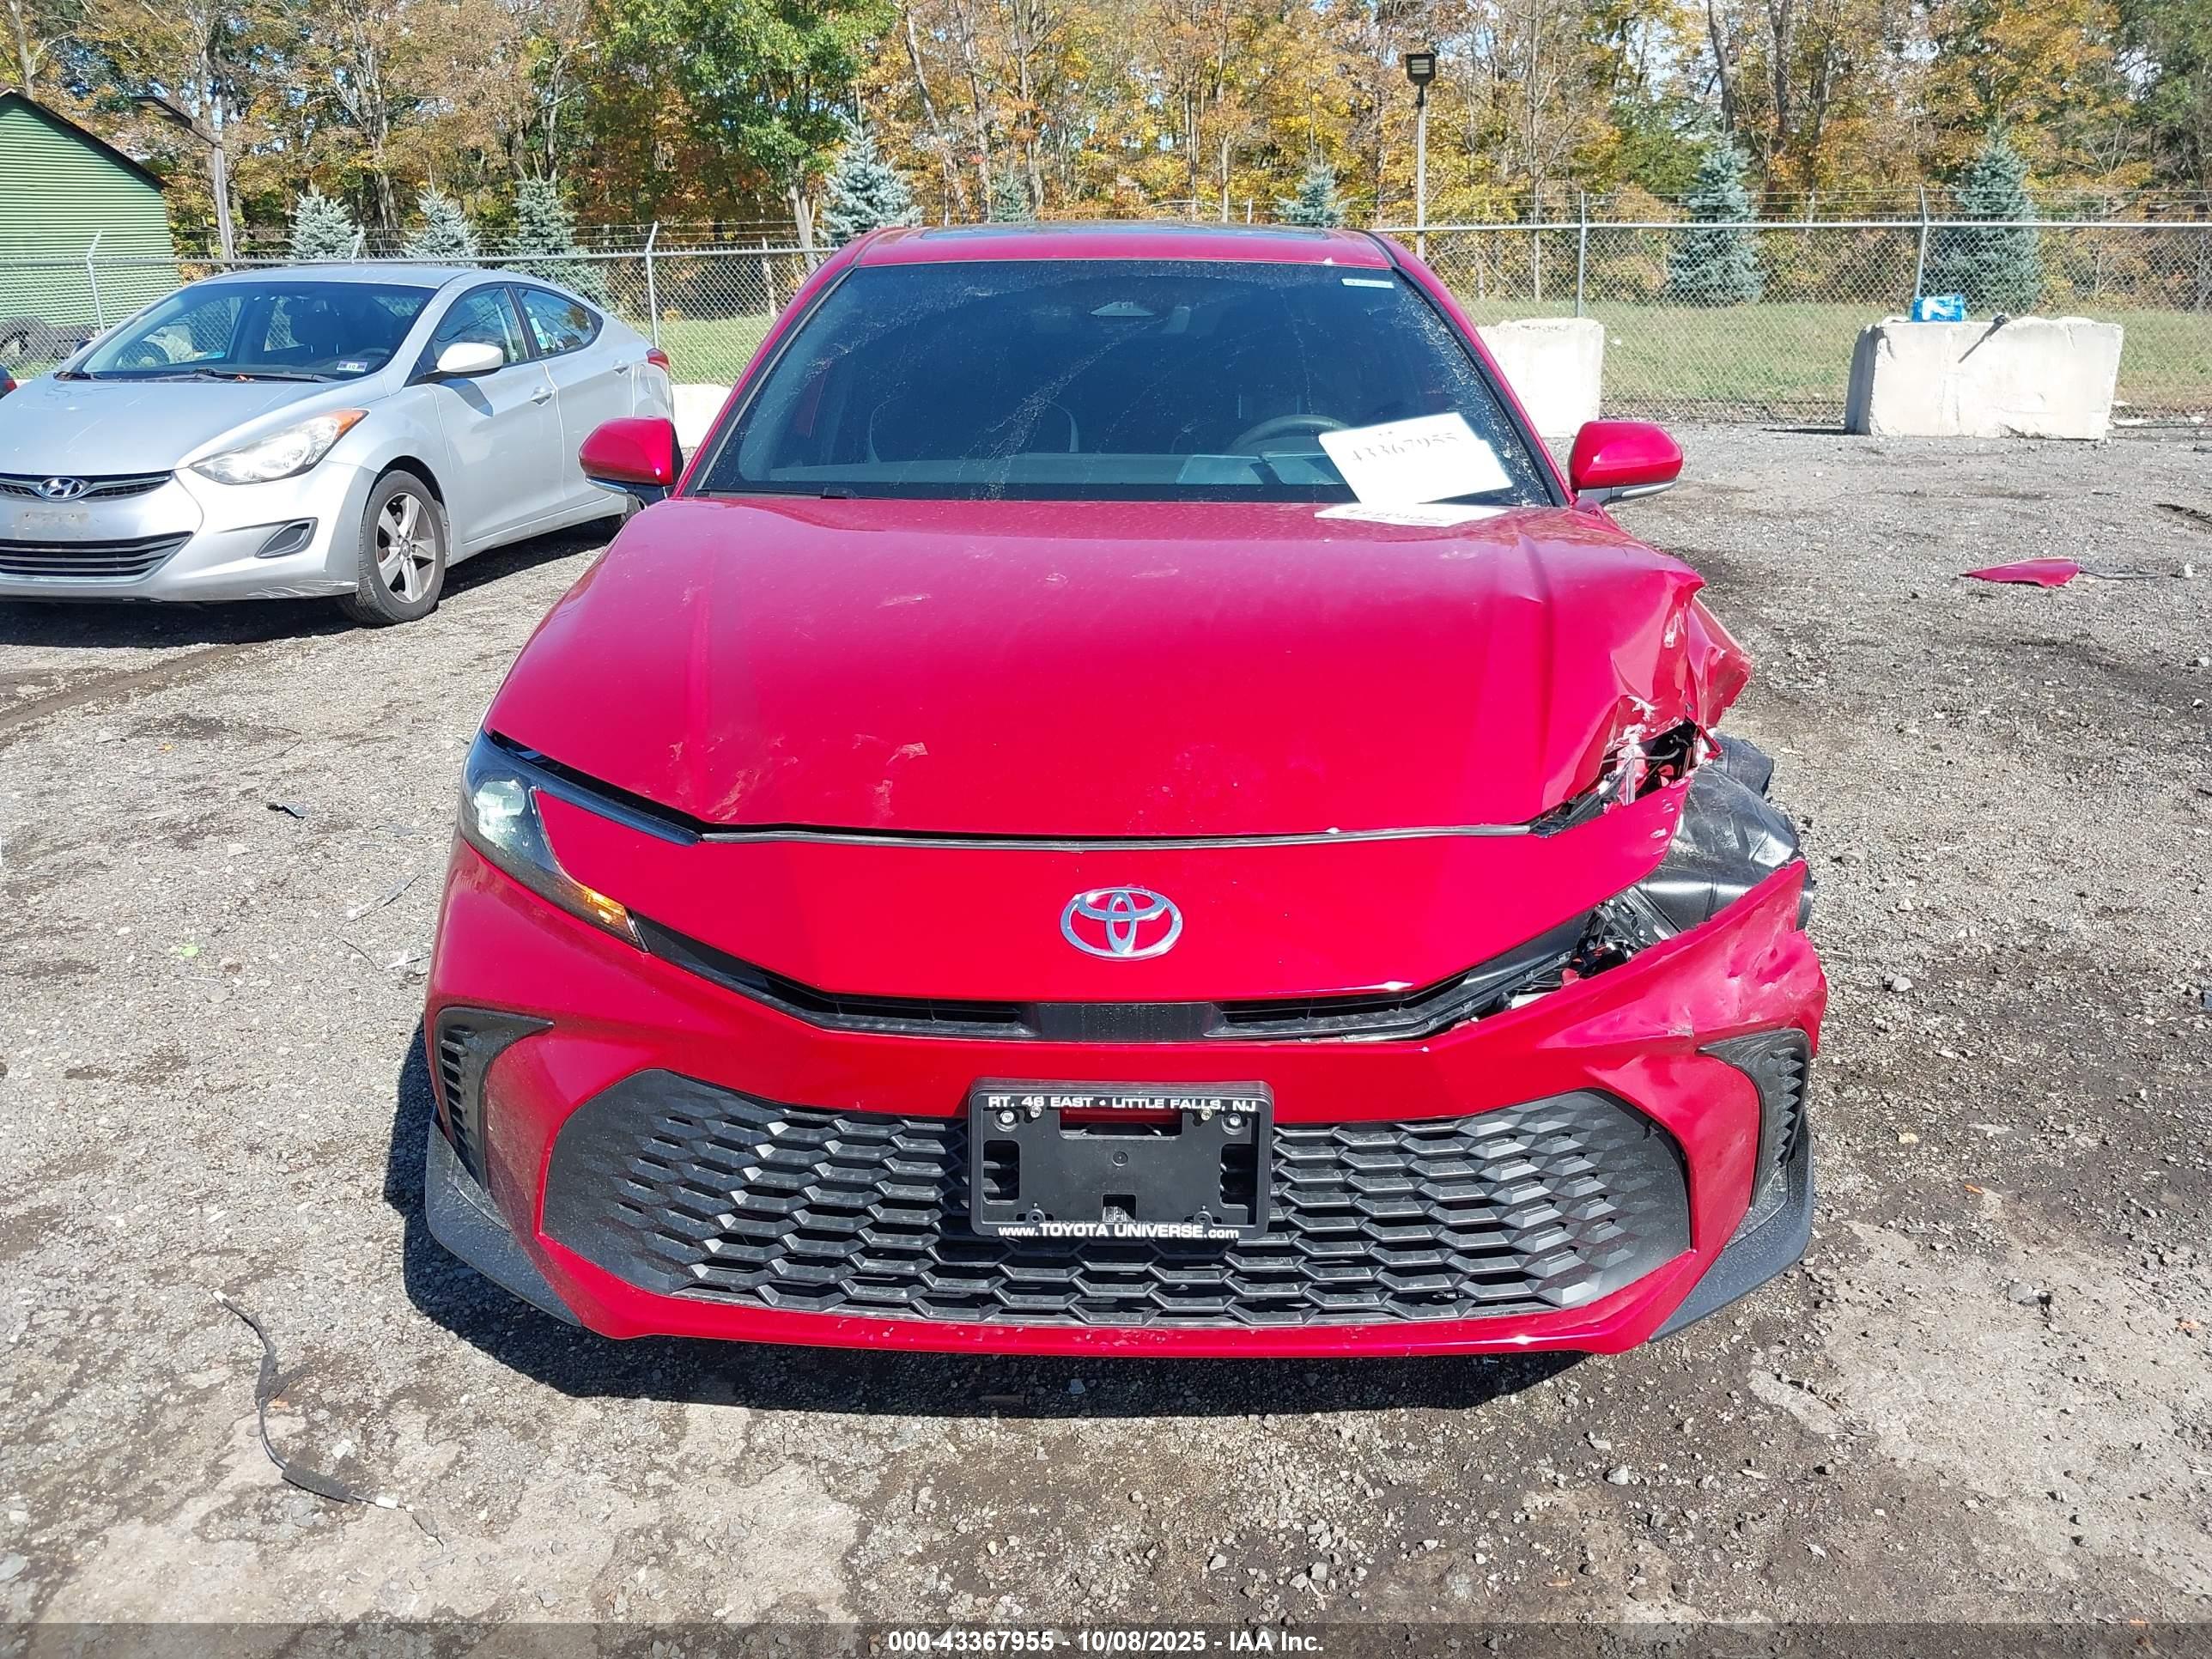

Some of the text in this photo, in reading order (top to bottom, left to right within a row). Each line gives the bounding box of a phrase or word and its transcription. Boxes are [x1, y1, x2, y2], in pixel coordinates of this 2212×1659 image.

[988, 1096, 1256, 1112] RT. 46 EAST LITTLE FALLS, NJ
[998, 1223, 1240, 1239] www.TOYOTA UNIVERSE.com
